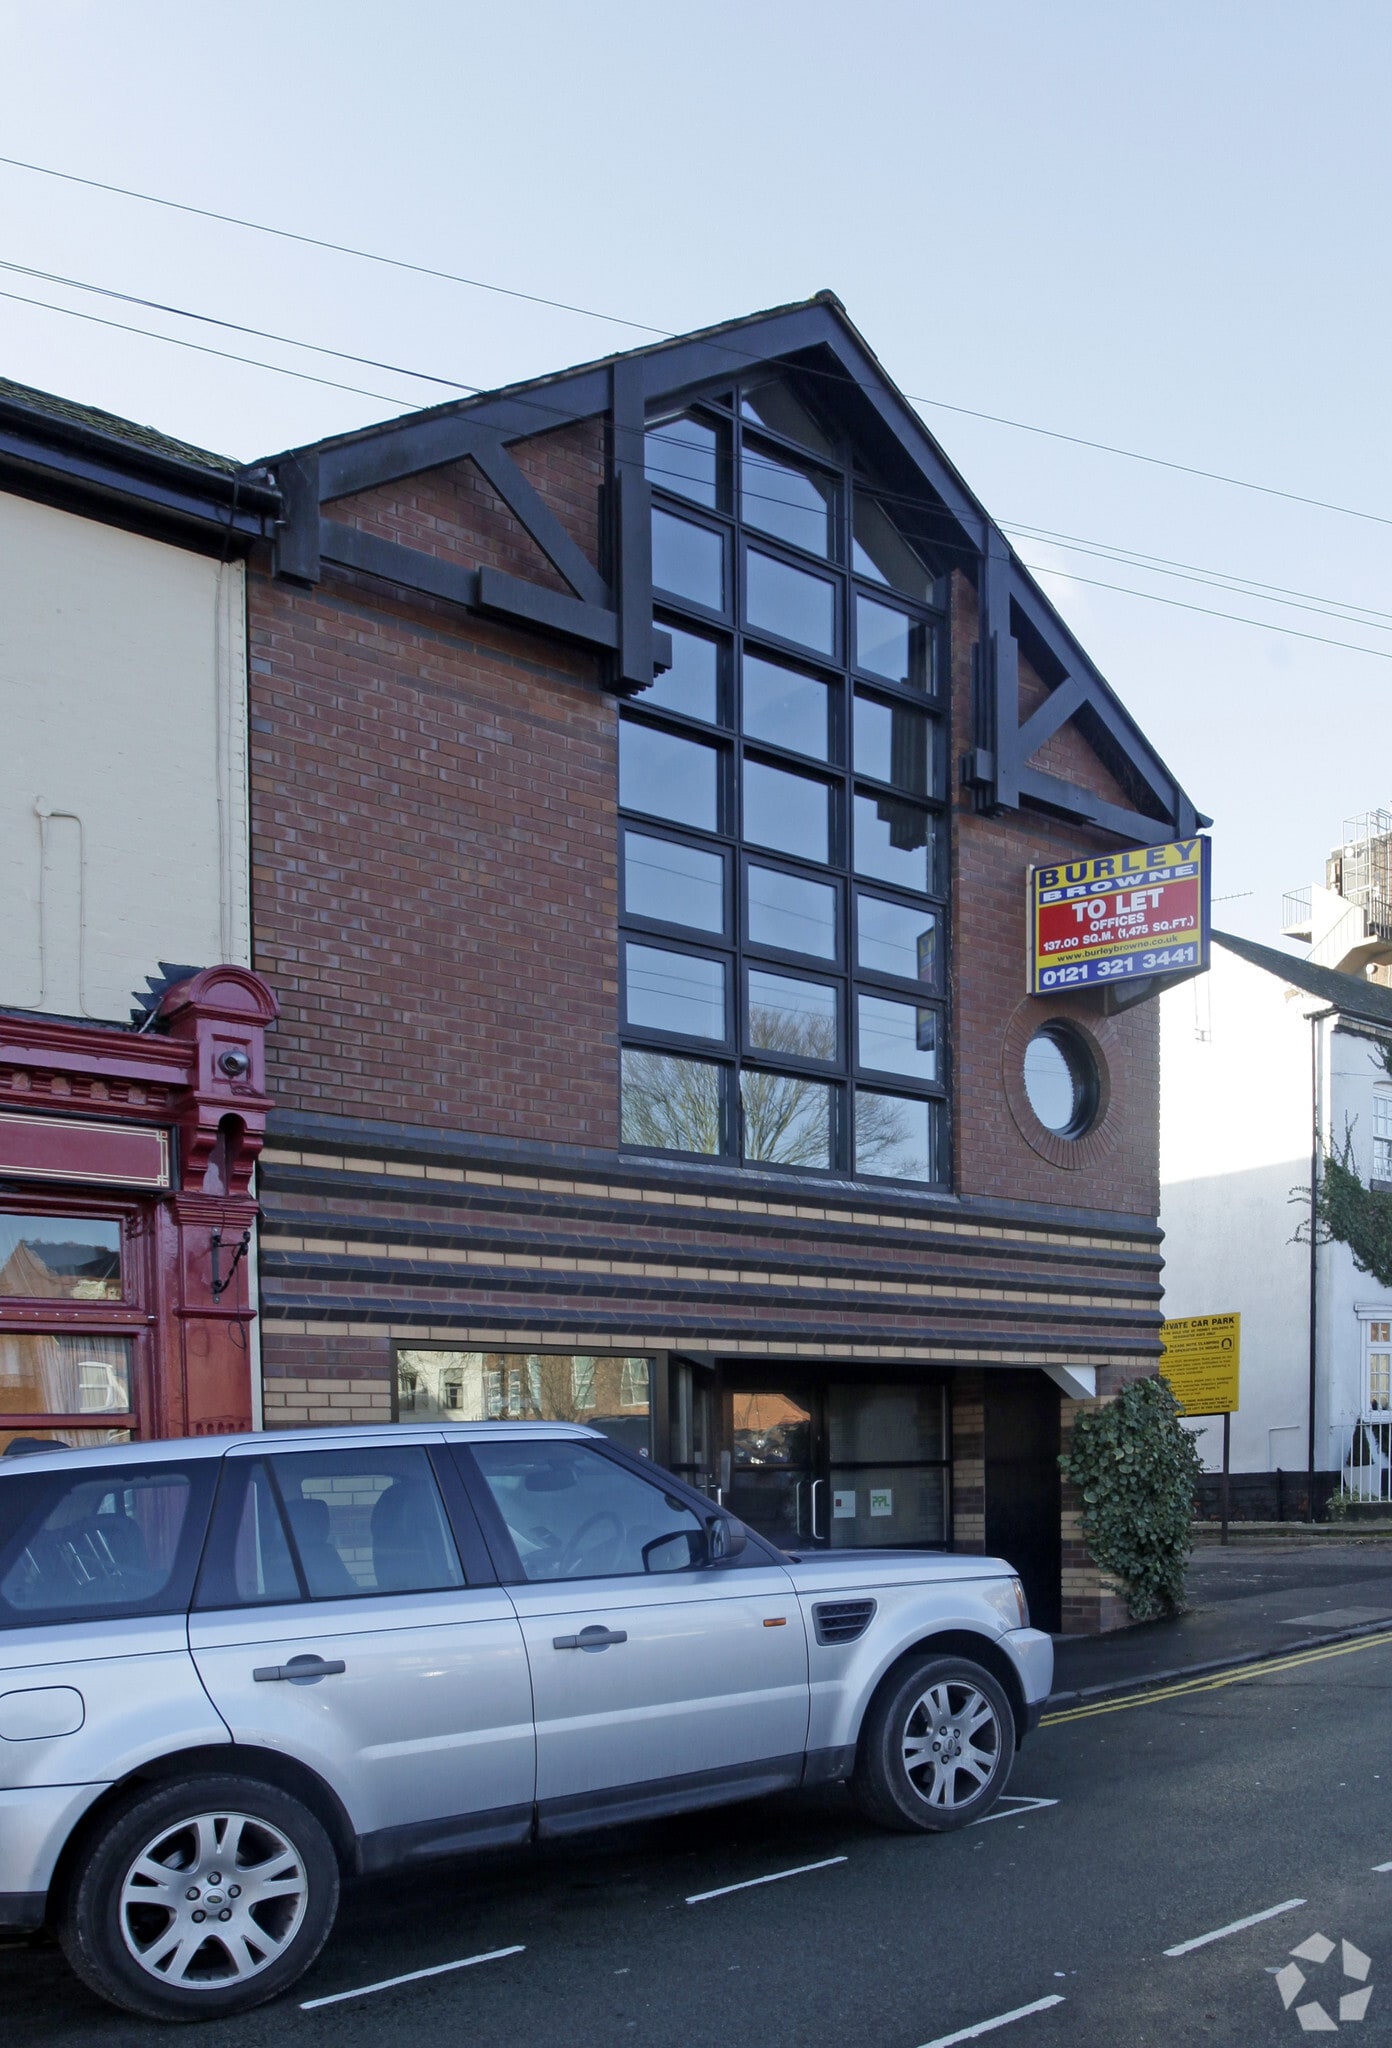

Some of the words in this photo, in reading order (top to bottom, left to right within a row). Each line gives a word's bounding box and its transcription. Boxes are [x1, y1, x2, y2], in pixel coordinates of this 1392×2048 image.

[1039, 840, 1198, 889] BURLEY
[1042, 864, 1194, 903] BROWNE
[1072, 899, 1106, 923] TO
[1115, 887, 1164, 915] LET
[1090, 912, 1145, 932] OFFICES
[1043, 937, 1079, 952] 137.00
[1083, 930, 1114, 945] SQ.M.
[1118, 925, 1149, 941] (1,475
[1153, 916, 1194, 932] SQ.FT.)
[1057, 935, 1178, 963] www.burleybrowne.co.uk
[1043, 965, 1088, 986] 0121
[1097, 957, 1133, 976] 321
[1143, 947, 1194, 969] 3441
[1161, 1321, 1188, 1331] RIVATE
[1211, 1317, 1234, 1325] PARK
[872, 1495, 890, 1507] PPL
